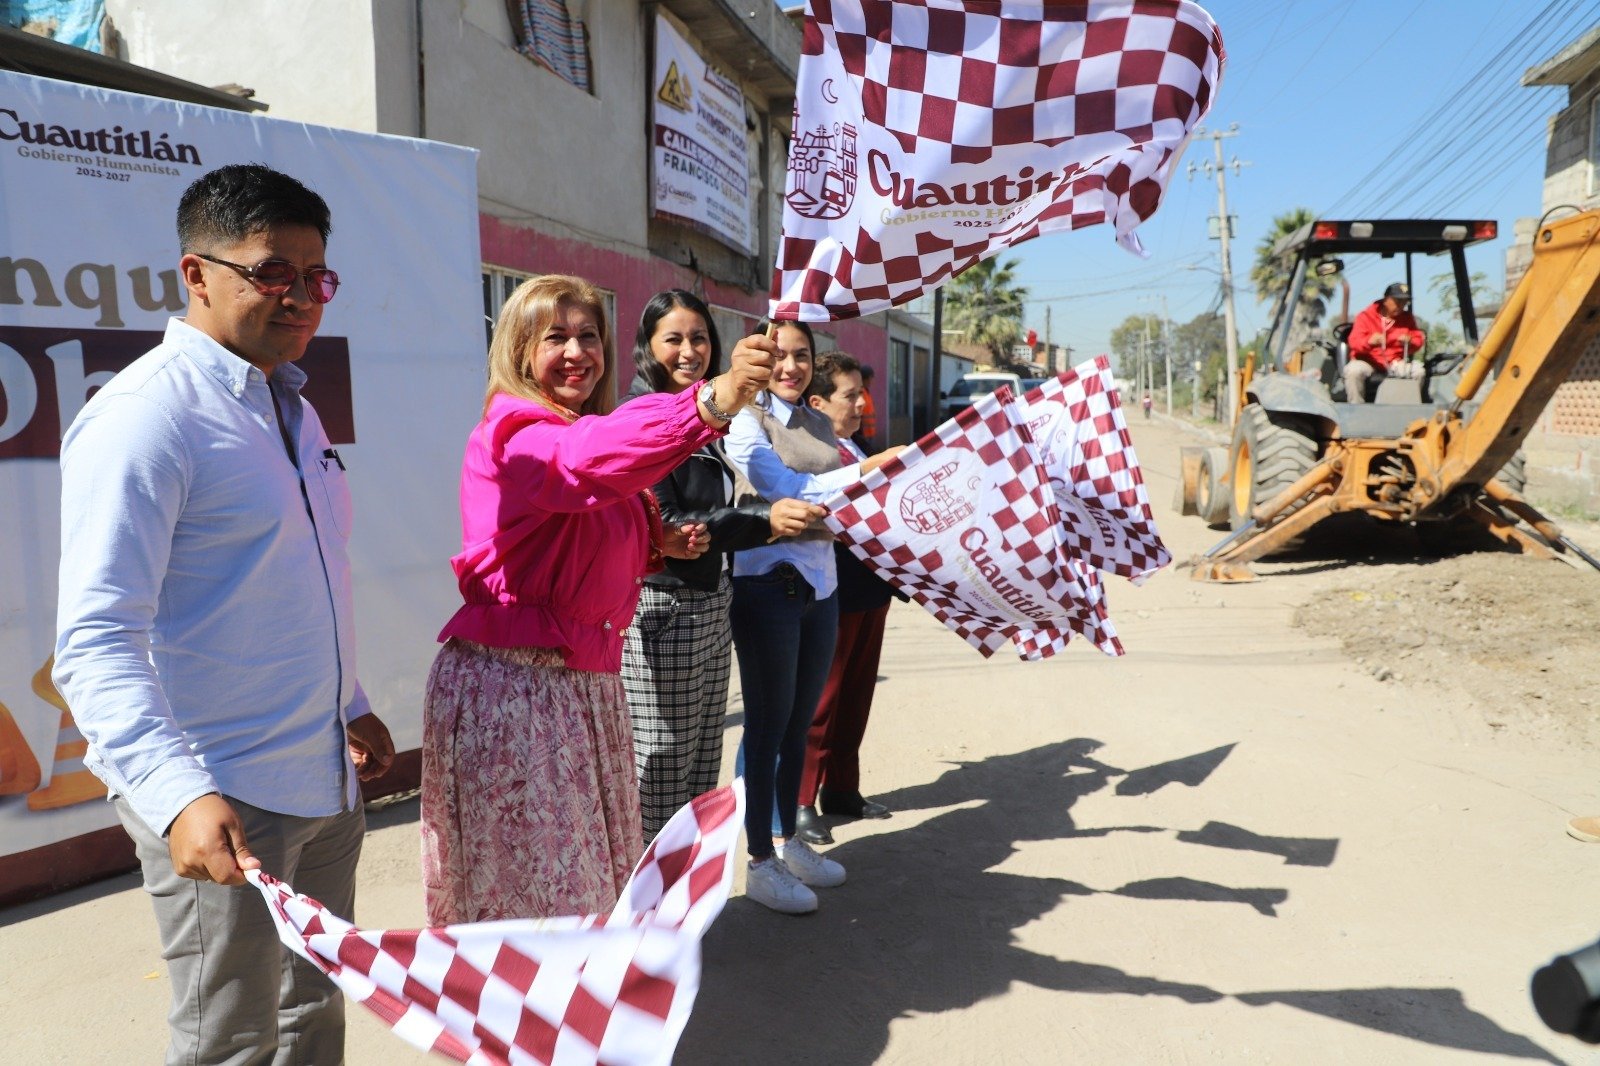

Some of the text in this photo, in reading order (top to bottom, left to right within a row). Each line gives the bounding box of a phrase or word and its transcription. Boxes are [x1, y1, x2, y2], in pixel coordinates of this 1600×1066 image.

[0, 108, 202, 165] Cuautitlán
[17, 146, 180, 177] Gobierno Humanista
[77, 167, 131, 182] 2025-2027
[880, 207, 980, 226] Gobierno
